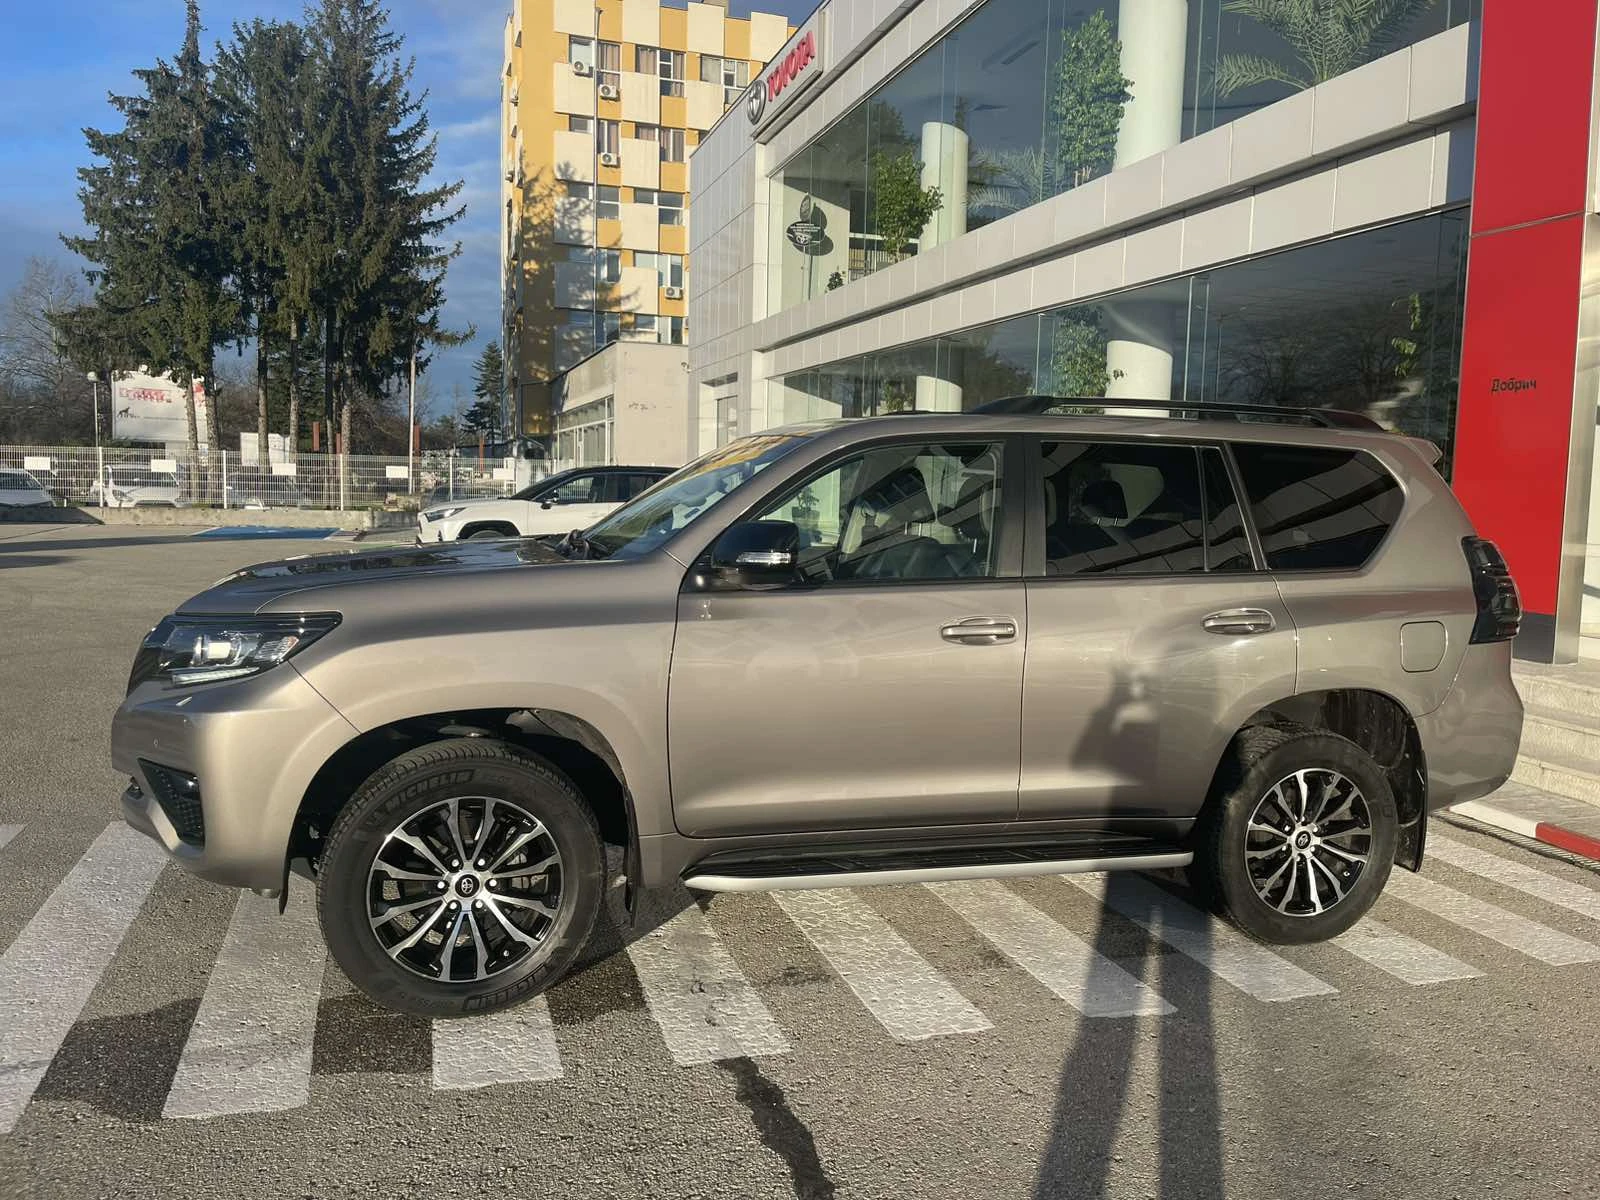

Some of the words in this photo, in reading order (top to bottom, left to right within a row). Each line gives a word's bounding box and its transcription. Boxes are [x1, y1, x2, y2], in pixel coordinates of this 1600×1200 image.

[767, 31, 815, 102] TOYOTA
[1491, 378, 1537, 394] Добрич
[385, 769, 476, 811] MICHELIN
